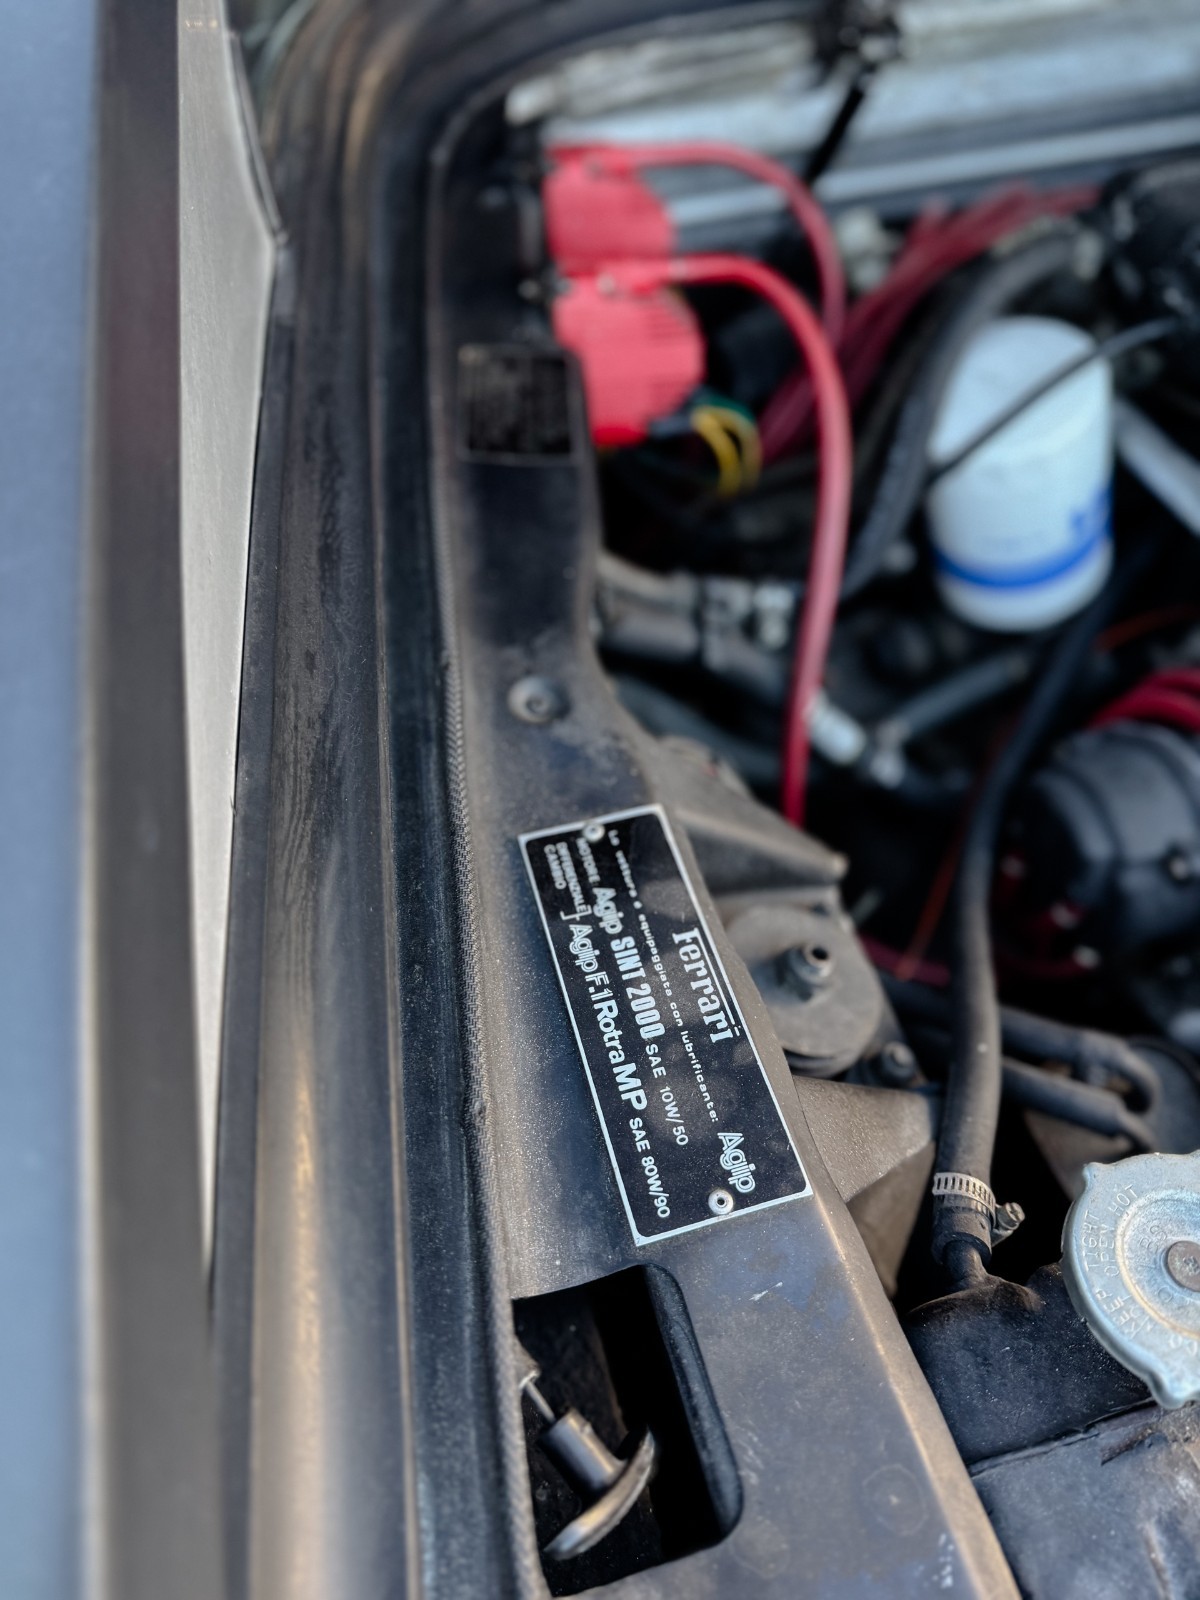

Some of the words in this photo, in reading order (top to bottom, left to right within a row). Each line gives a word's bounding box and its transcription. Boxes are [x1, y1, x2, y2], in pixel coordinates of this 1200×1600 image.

[544, 844, 567, 890] CAMBIO
[556, 842, 588, 913] DIFFERENZIALE
[593, 887, 624, 935] Agip
[569, 924, 600, 972] Agip
[611, 937, 646, 980] SINT
[616, 850, 637, 898] vettura
[639, 915, 672, 996] equipaggiata
[670, 1002, 683, 1026] con
[681, 1031, 718, 1122] lubrificante:
[626, 983, 665, 1039] 2000
[672, 928, 741, 1043] Ferrari
[594, 1000, 629, 1064] Rotra
[613, 1063, 647, 1110] MP
[646, 1044, 666, 1078] SAE
[629, 1118, 650, 1152] SAE
[660, 1086, 688, 1145] 10W/50
[642, 1156, 670, 1218] 80W/90
[717, 1133, 756, 1193] Agip
[1108, 1184, 1138, 1217] HOT
[1082, 1210, 1101, 1273] TIGHT
[1099, 1223, 1119, 1277] OPEN
[1095, 1288, 1140, 1340] KEEP
